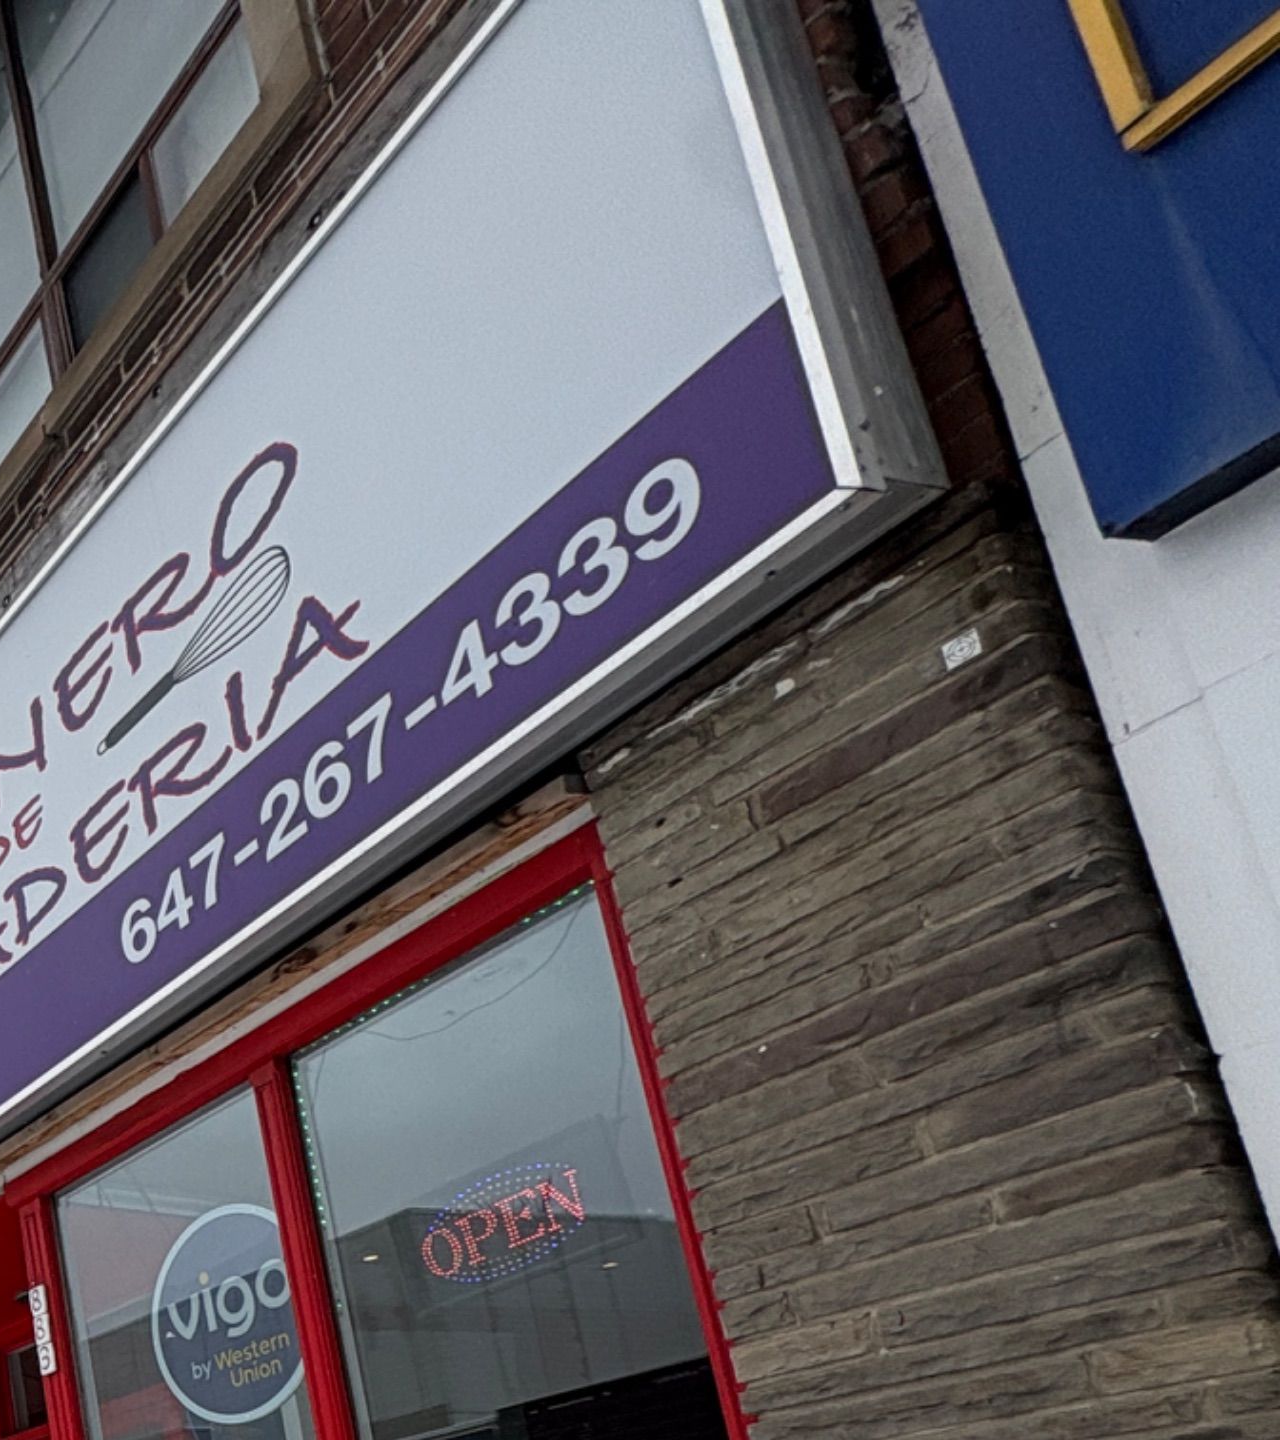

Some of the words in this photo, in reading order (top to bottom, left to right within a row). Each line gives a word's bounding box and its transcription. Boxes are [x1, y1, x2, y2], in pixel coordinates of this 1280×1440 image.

[120, 457, 701, 965] 647-267-4339
[421, 1168, 585, 1277] OPEN
[167, 1258, 292, 1341] vigo
[191, 1360, 213, 1381] by
[214, 1332, 290, 1371] Western
[230, 1357, 282, 1388] Union
